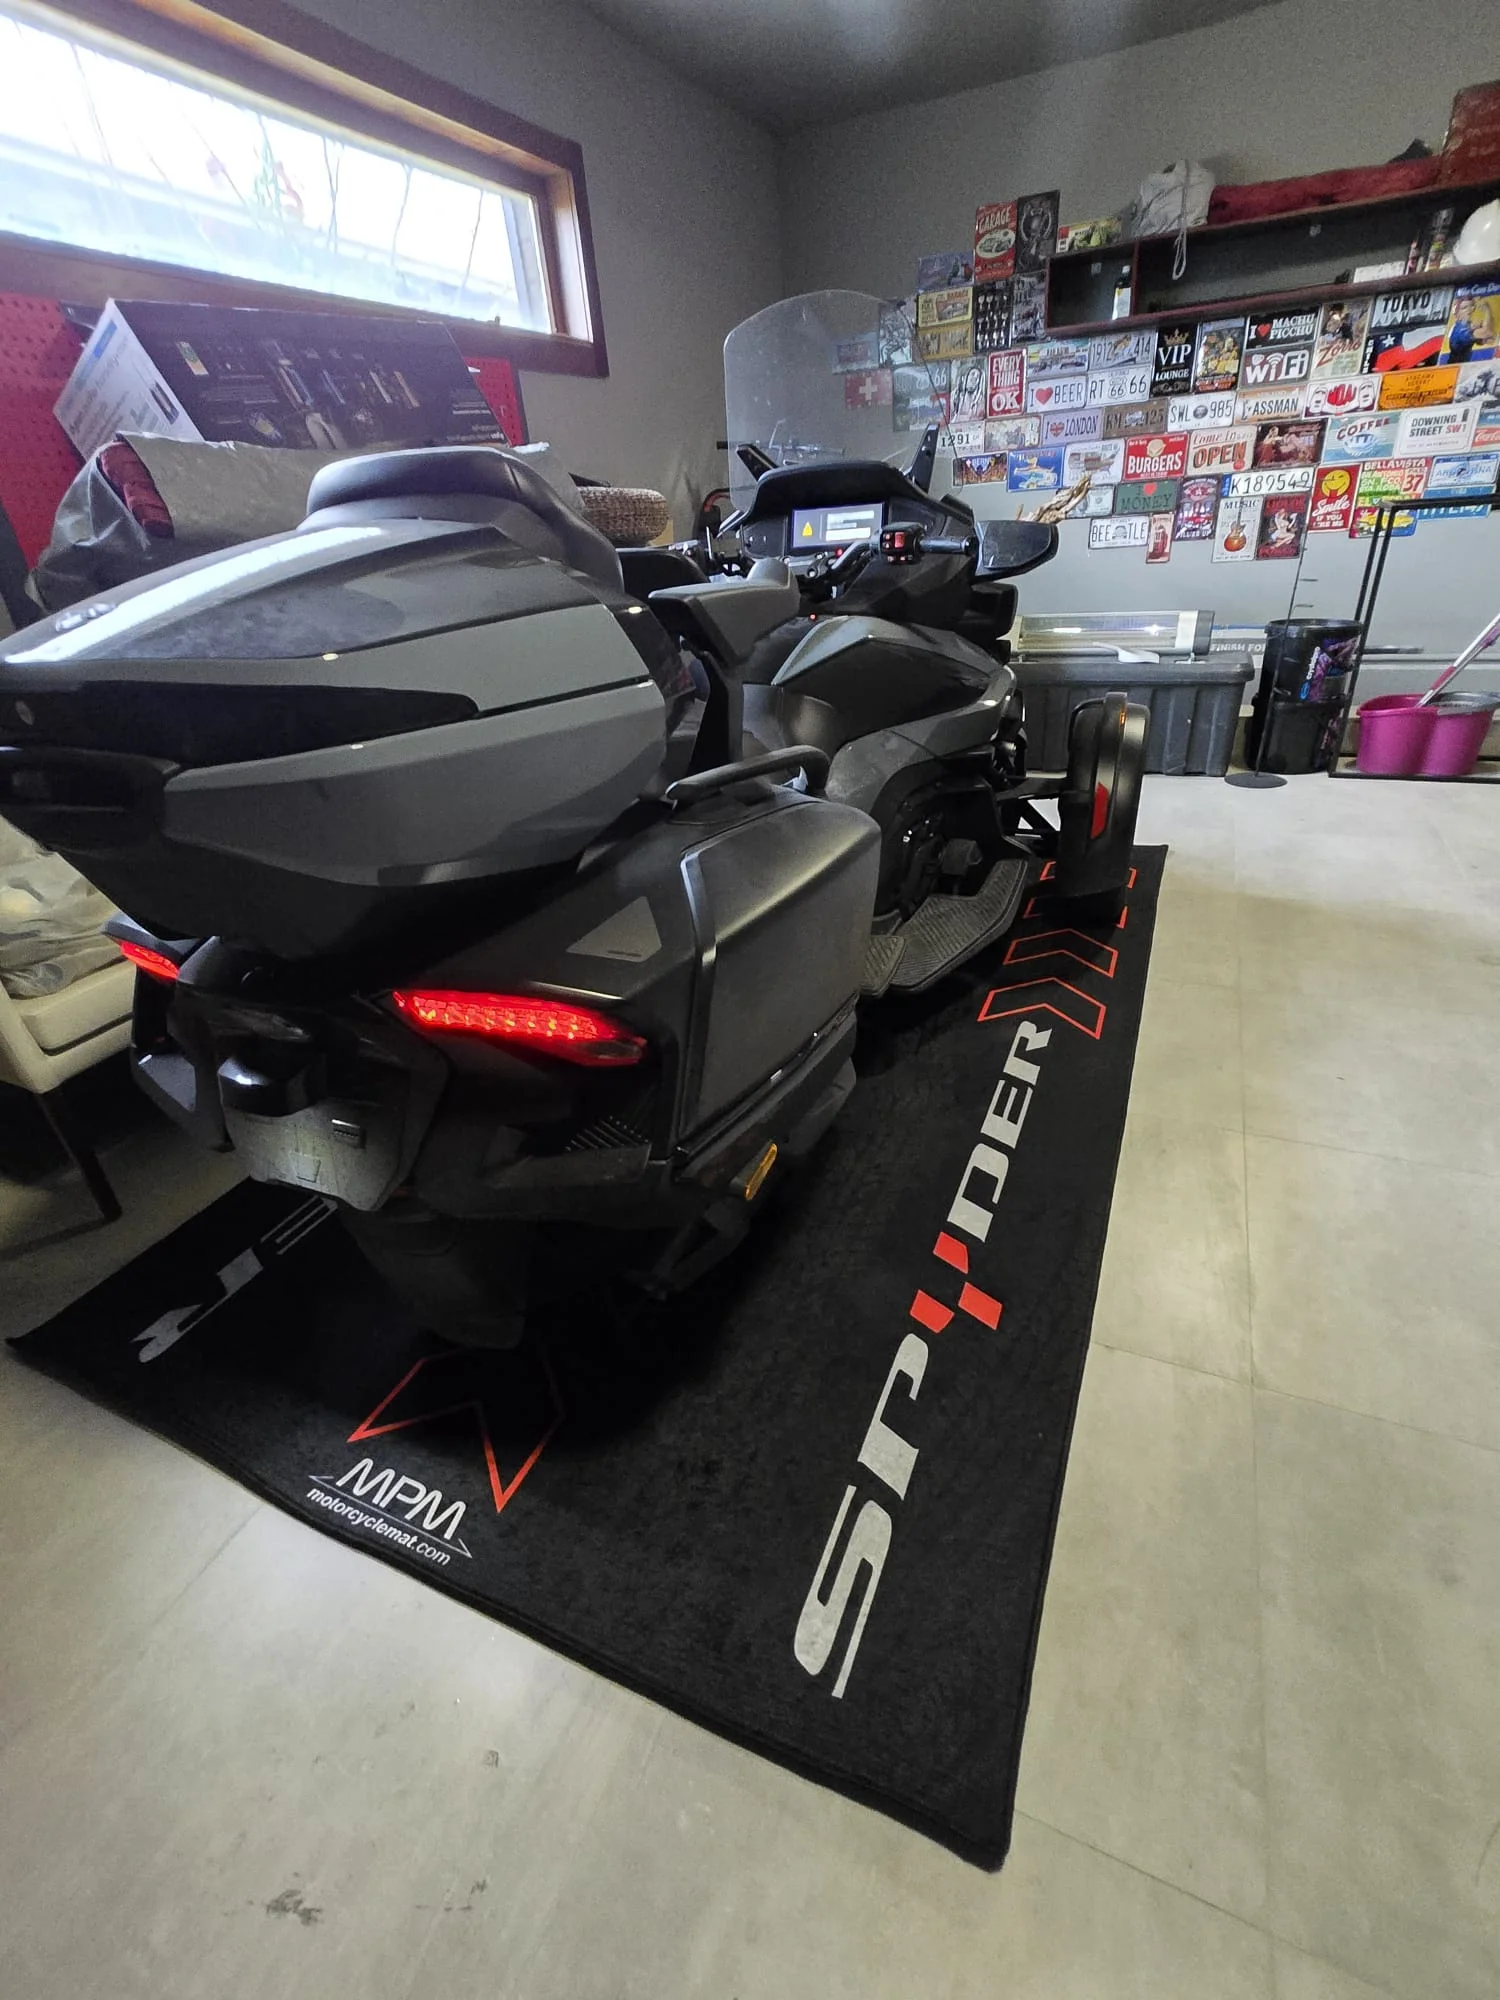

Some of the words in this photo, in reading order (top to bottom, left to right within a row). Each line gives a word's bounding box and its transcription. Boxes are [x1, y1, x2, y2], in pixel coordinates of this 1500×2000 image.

[979, 205, 1012, 234] GARAGE
[1383, 292, 1431, 313] TOKYO
[1272, 313, 1315, 328] MACHU
[1249, 324, 1258, 340] I
[1269, 324, 1314, 340] PICCHU
[1093, 341, 1112, 362] 1912
[1158, 343, 1191, 365] VIP
[1362, 339, 1374, 374] CHILE
[993, 354, 1021, 372] EVERY
[993, 370, 1020, 387] THING
[1155, 368, 1190, 381] LOUNGE
[1029, 388, 1034, 407] I
[1054, 382, 1082, 404] BEER
[1089, 379, 1105, 400] RT
[1110, 380, 1124, 397] 66
[1129, 374, 1147, 394] 66
[992, 391, 1020, 411] OK
[1209, 399, 1233, 419] 985
[1252, 397, 1299, 416] ASSMAN
[1045, 422, 1050, 440] I
[1064, 415, 1099, 437] LONDON
[1336, 417, 1390, 441] COFFEE
[1411, 414, 1458, 427] DOWNING
[941, 433, 970, 447] 1291
[1408, 425, 1444, 437] STREET
[1127, 451, 1183, 475] BURGERS
[1193, 441, 1247, 468] OPEN
[1364, 459, 1426, 471] BELLAVISTA
[1403, 474, 1424, 492] 37
[1121, 493, 1172, 510] MONEY
[1223, 499, 1257, 510] MUSIC
[1311, 494, 1351, 517] Smile
[1210, 643, 1246, 652] FINISH
[793, 1021, 1052, 1699] SPYDER
[335, 1458, 467, 1540] MPM
[306, 1488, 451, 1566] motorcyclemat.com
